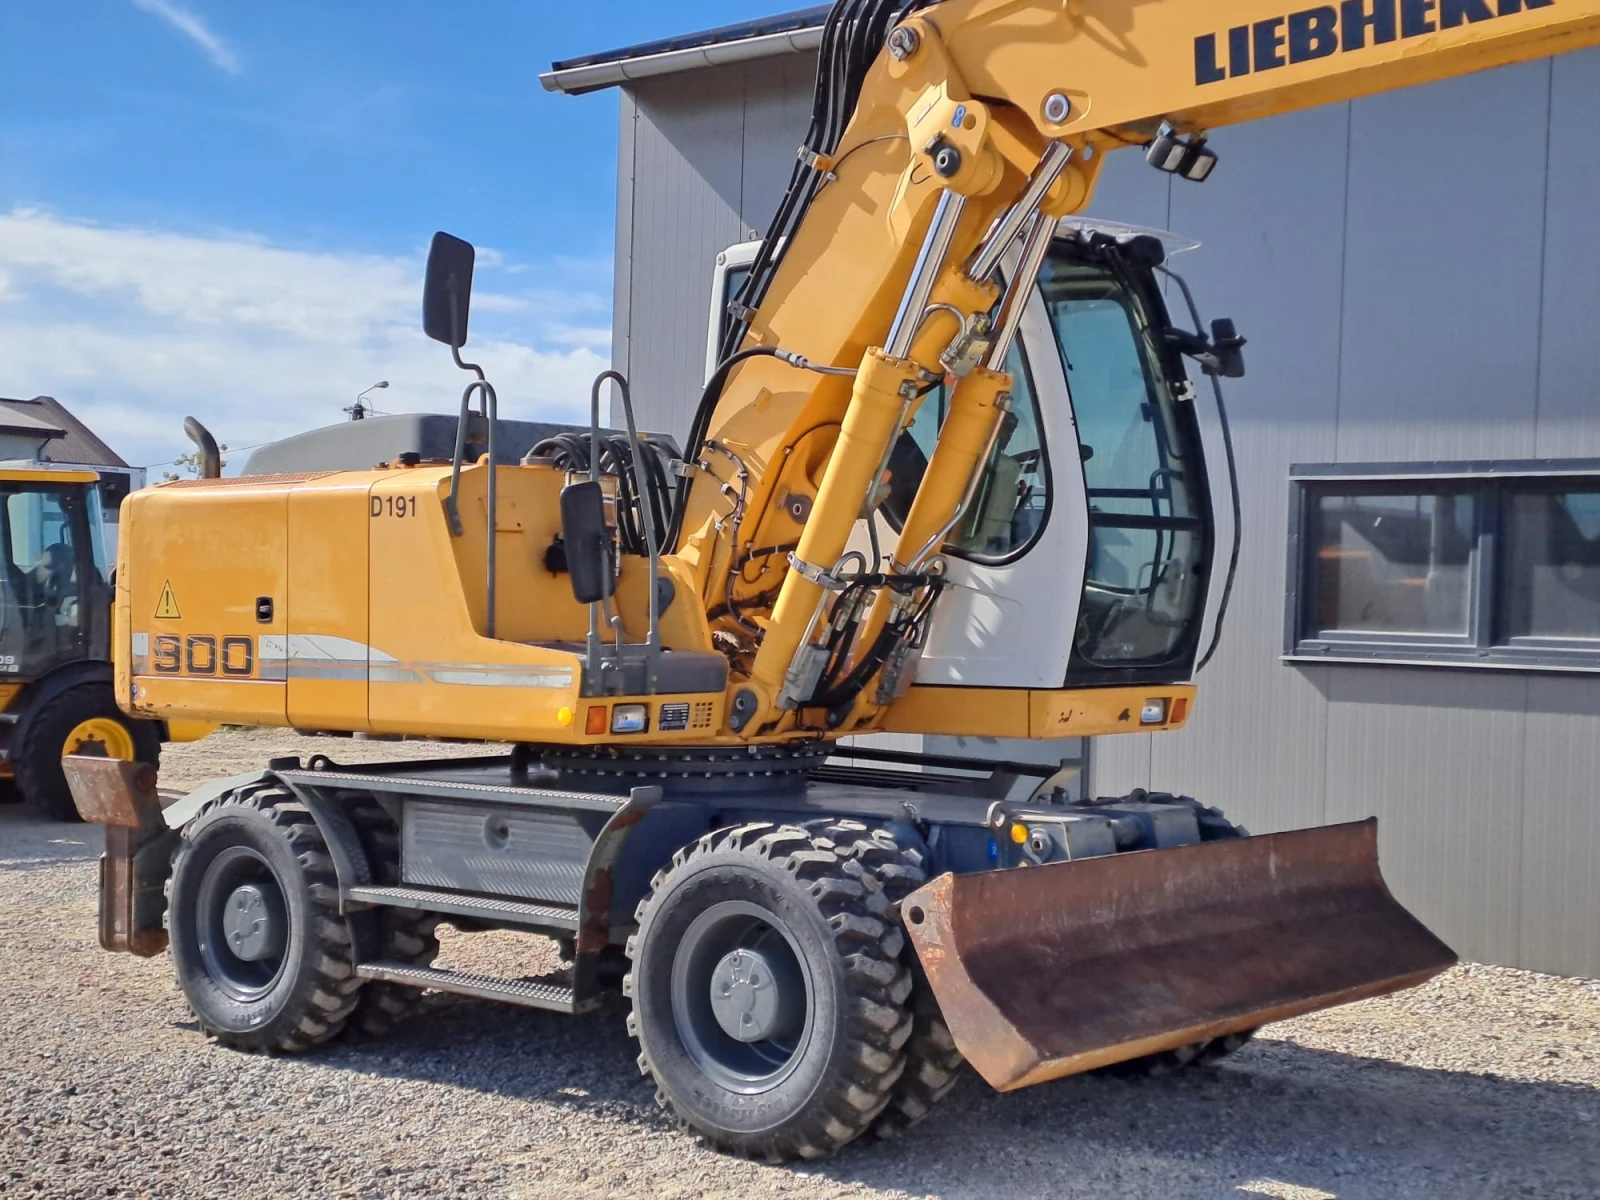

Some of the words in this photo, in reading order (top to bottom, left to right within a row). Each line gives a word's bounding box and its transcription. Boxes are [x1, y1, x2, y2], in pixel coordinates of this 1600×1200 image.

[1194, 0, 1556, 86] LIEBHER
[370, 495, 416, 519] D191
[154, 634, 253, 676] 900
